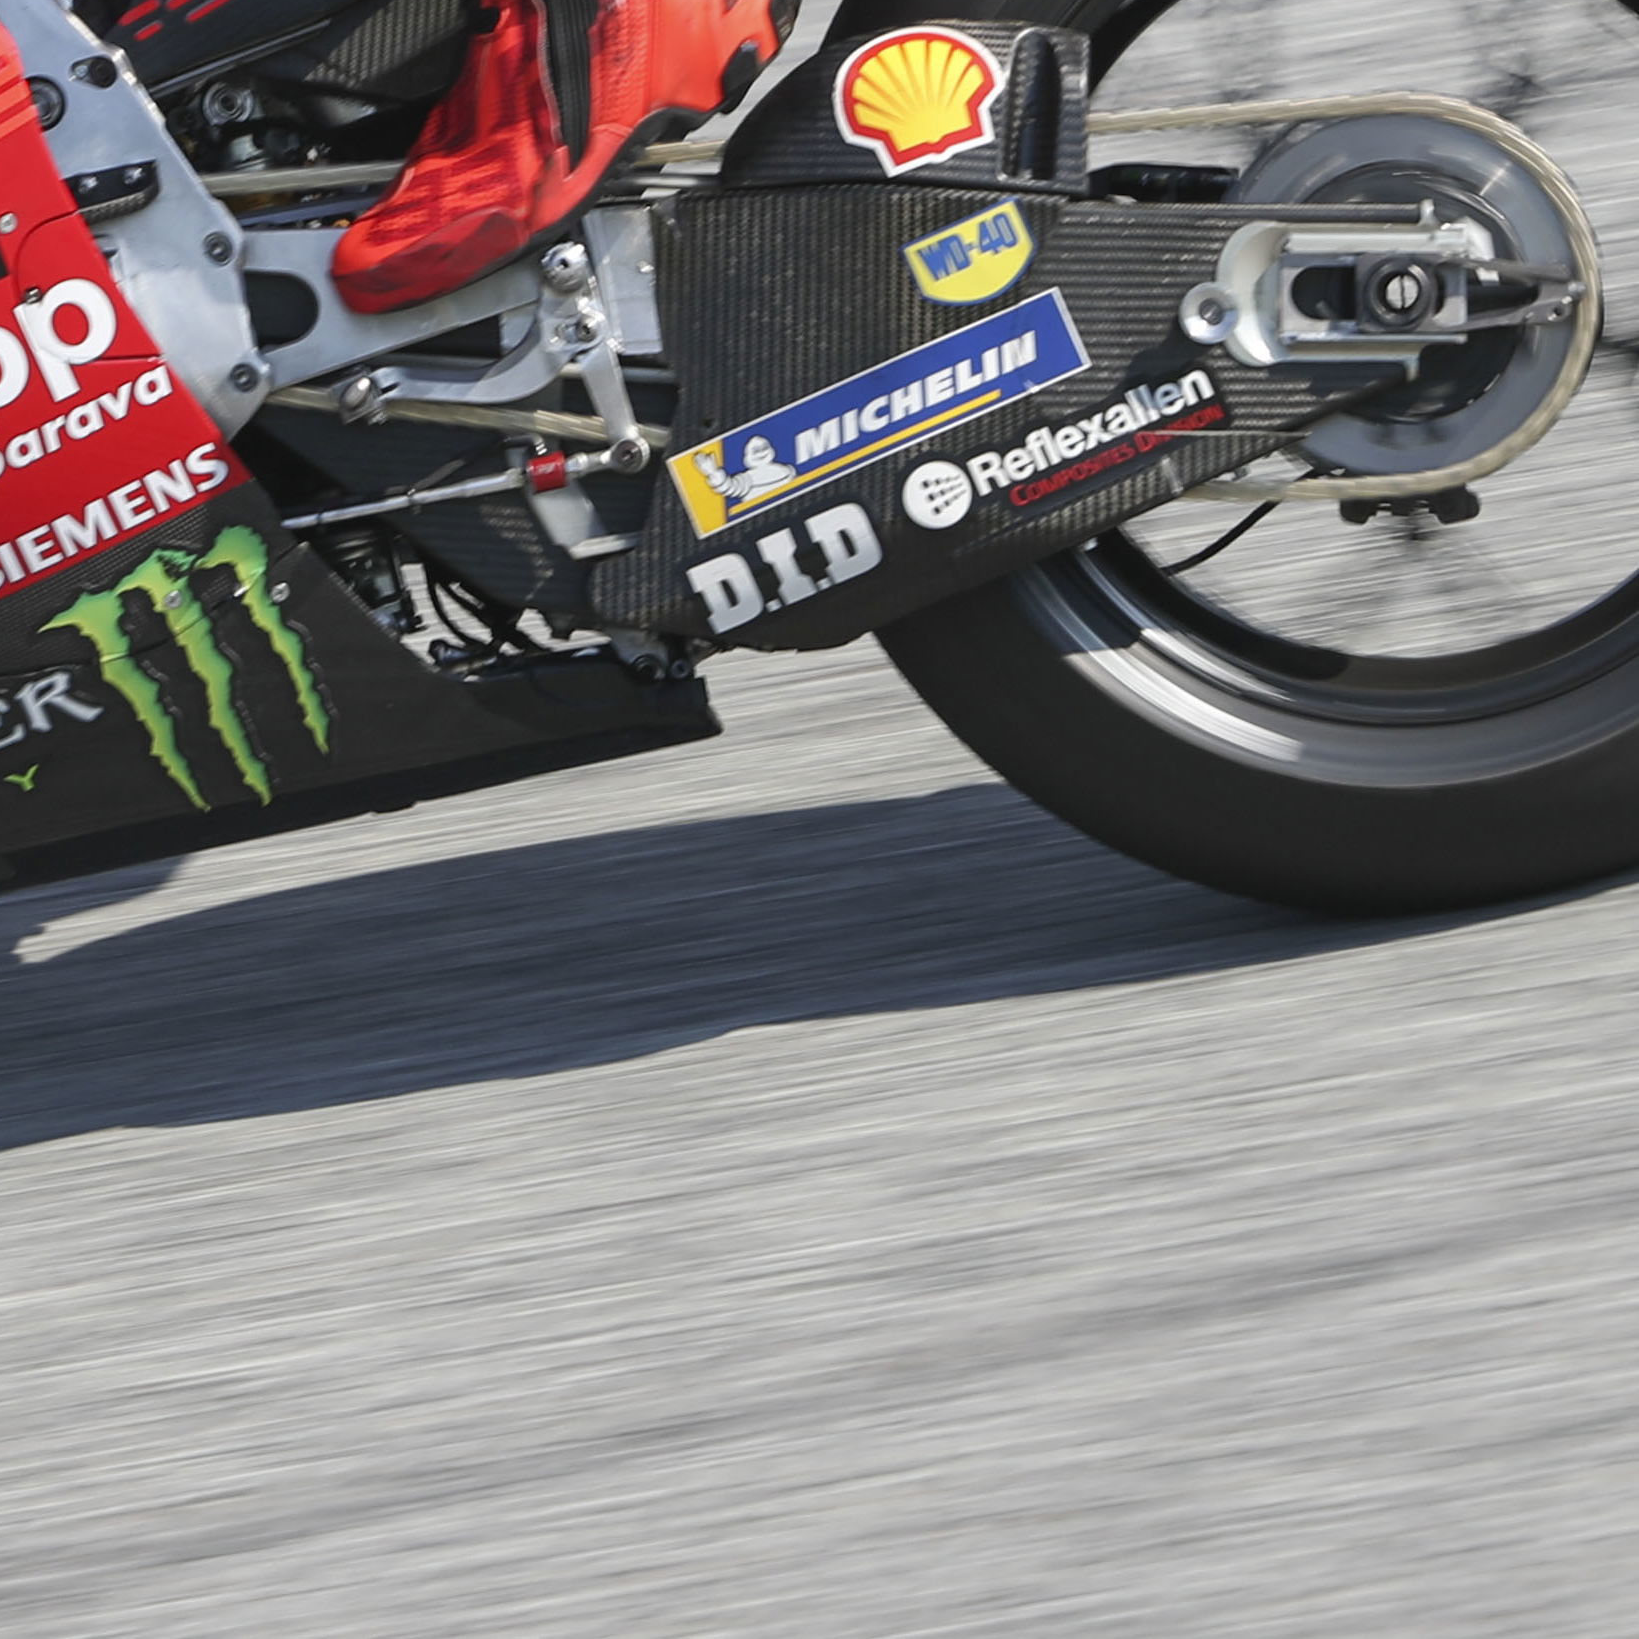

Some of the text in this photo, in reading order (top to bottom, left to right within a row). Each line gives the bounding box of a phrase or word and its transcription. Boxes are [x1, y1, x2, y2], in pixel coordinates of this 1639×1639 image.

[916, 212, 1019, 282] WD-40
[795, 330, 1037, 465] MICHELIN
[973, 369, 1216, 499] Reflexallen
